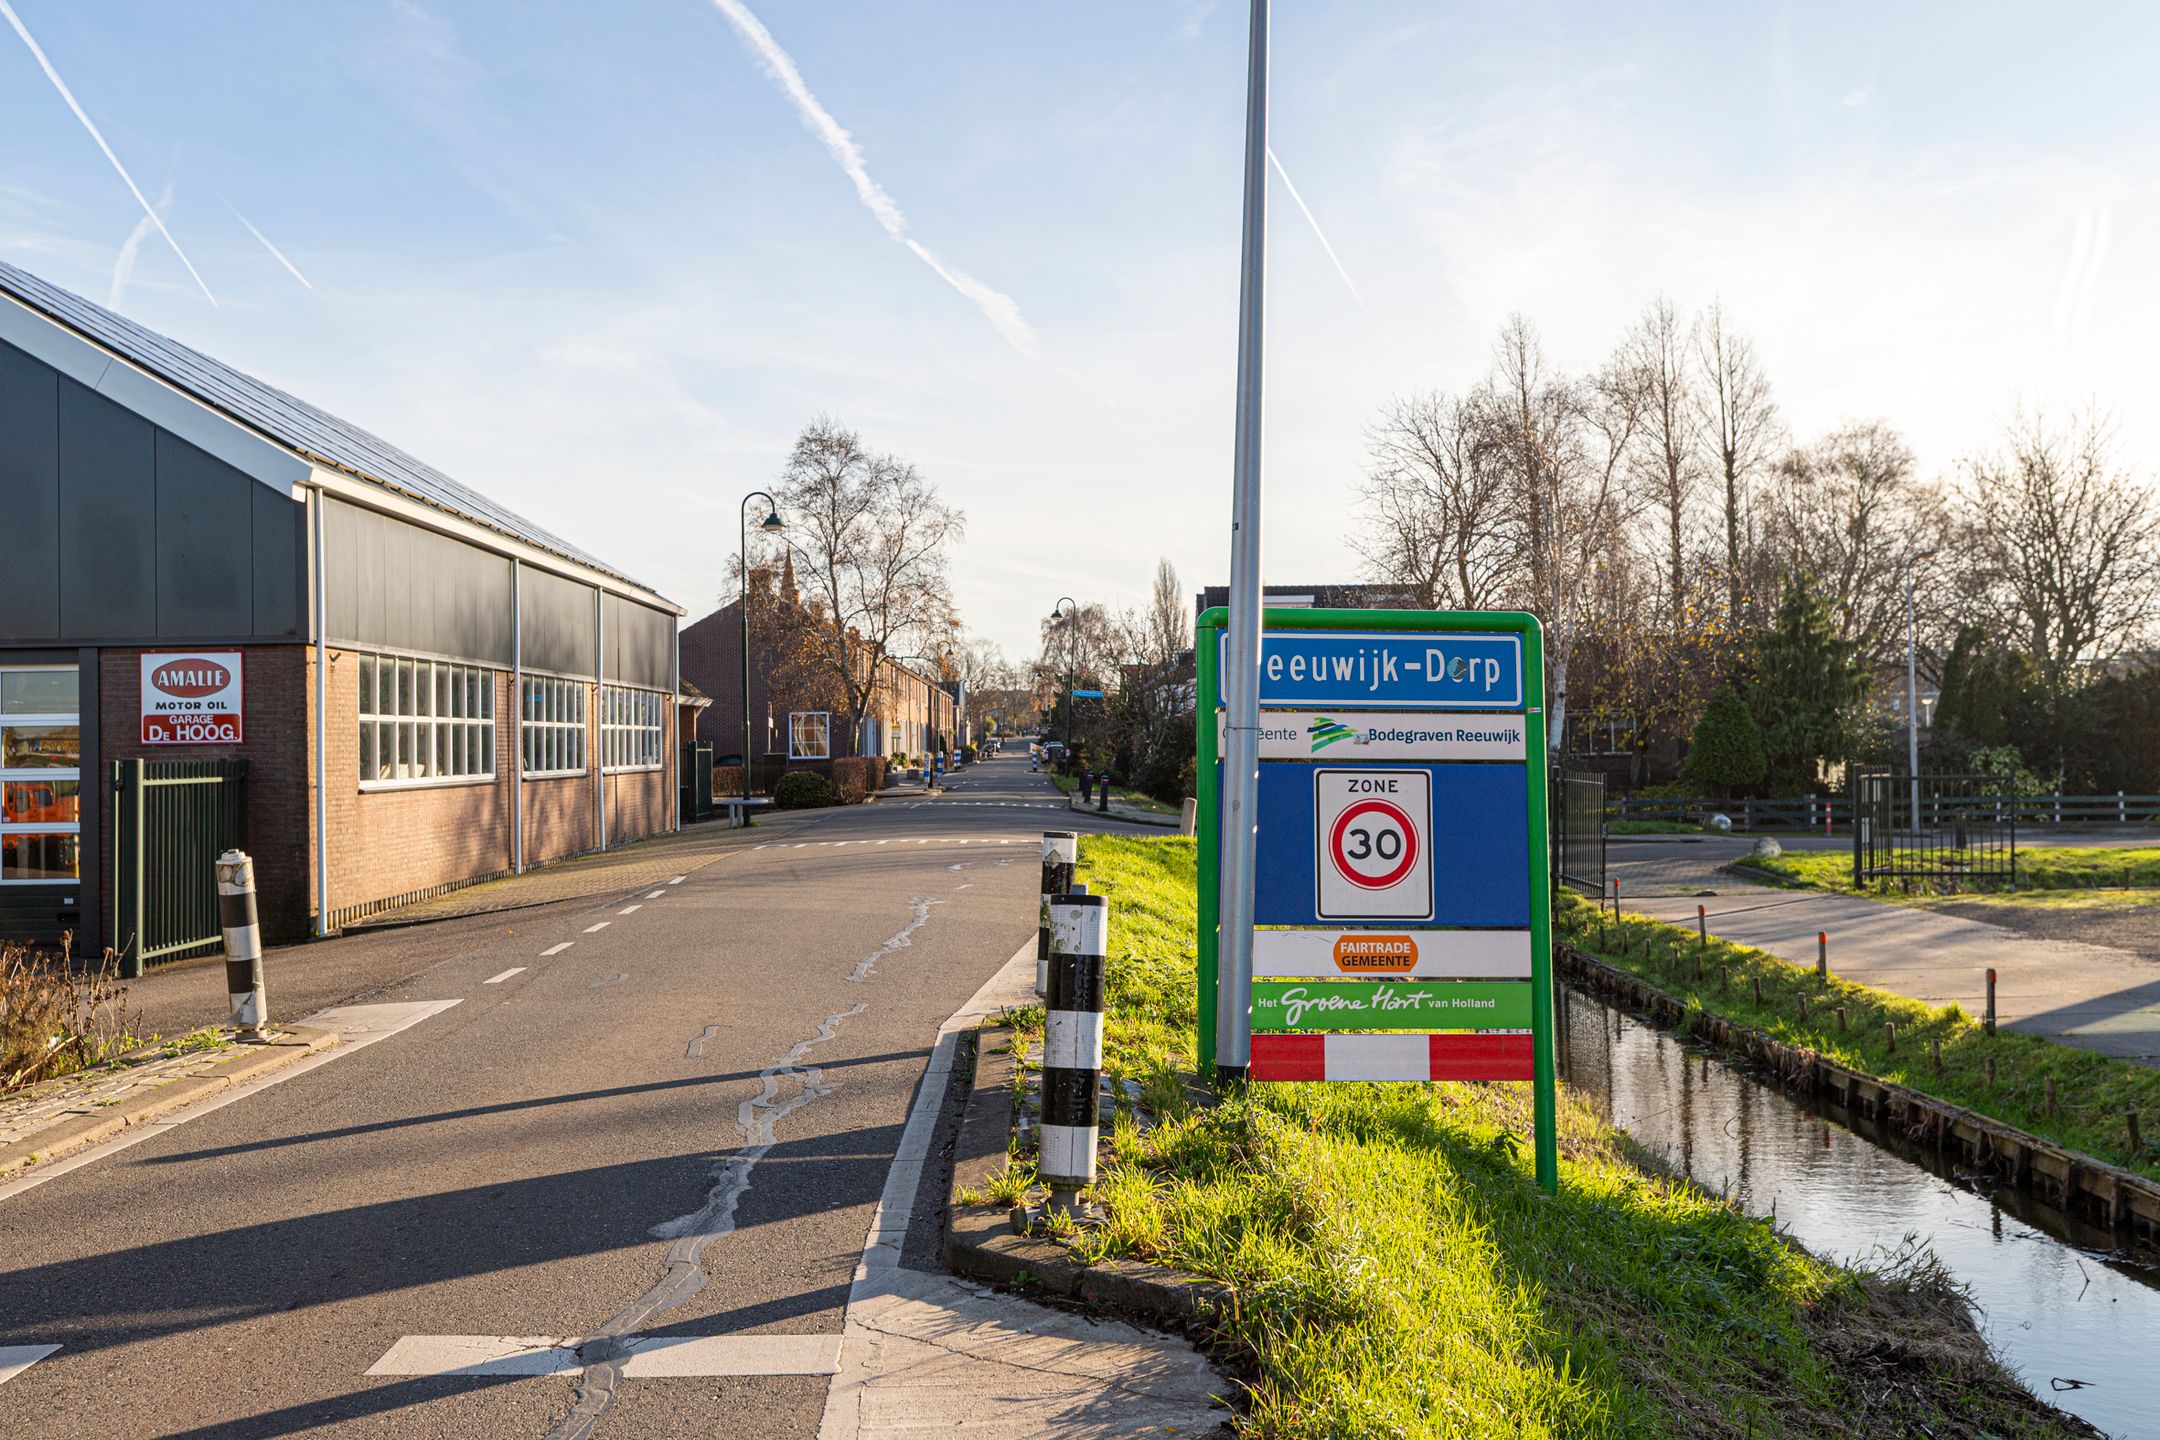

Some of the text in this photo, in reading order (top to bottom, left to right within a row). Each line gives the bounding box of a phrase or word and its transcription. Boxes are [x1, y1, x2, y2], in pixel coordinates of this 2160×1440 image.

[1267, 649, 1500, 692] eeuwijk-Drp
[158, 670, 223, 686] AMALIE
[155, 702, 201, 710] MOTOR
[169, 715, 213, 724] GARAGE
[1369, 728, 1452, 744] Bodegraven
[1456, 729, 1520, 744] Reeuwijk
[1348, 780, 1398, 793] ZONE
[1347, 829, 1401, 860] 30
[1340, 942, 1410, 953] FAIRTRADE
[1341, 956, 1410, 966] GEMEENTE
[1258, 985, 1495, 1026] Het Groene Hart van Holland
